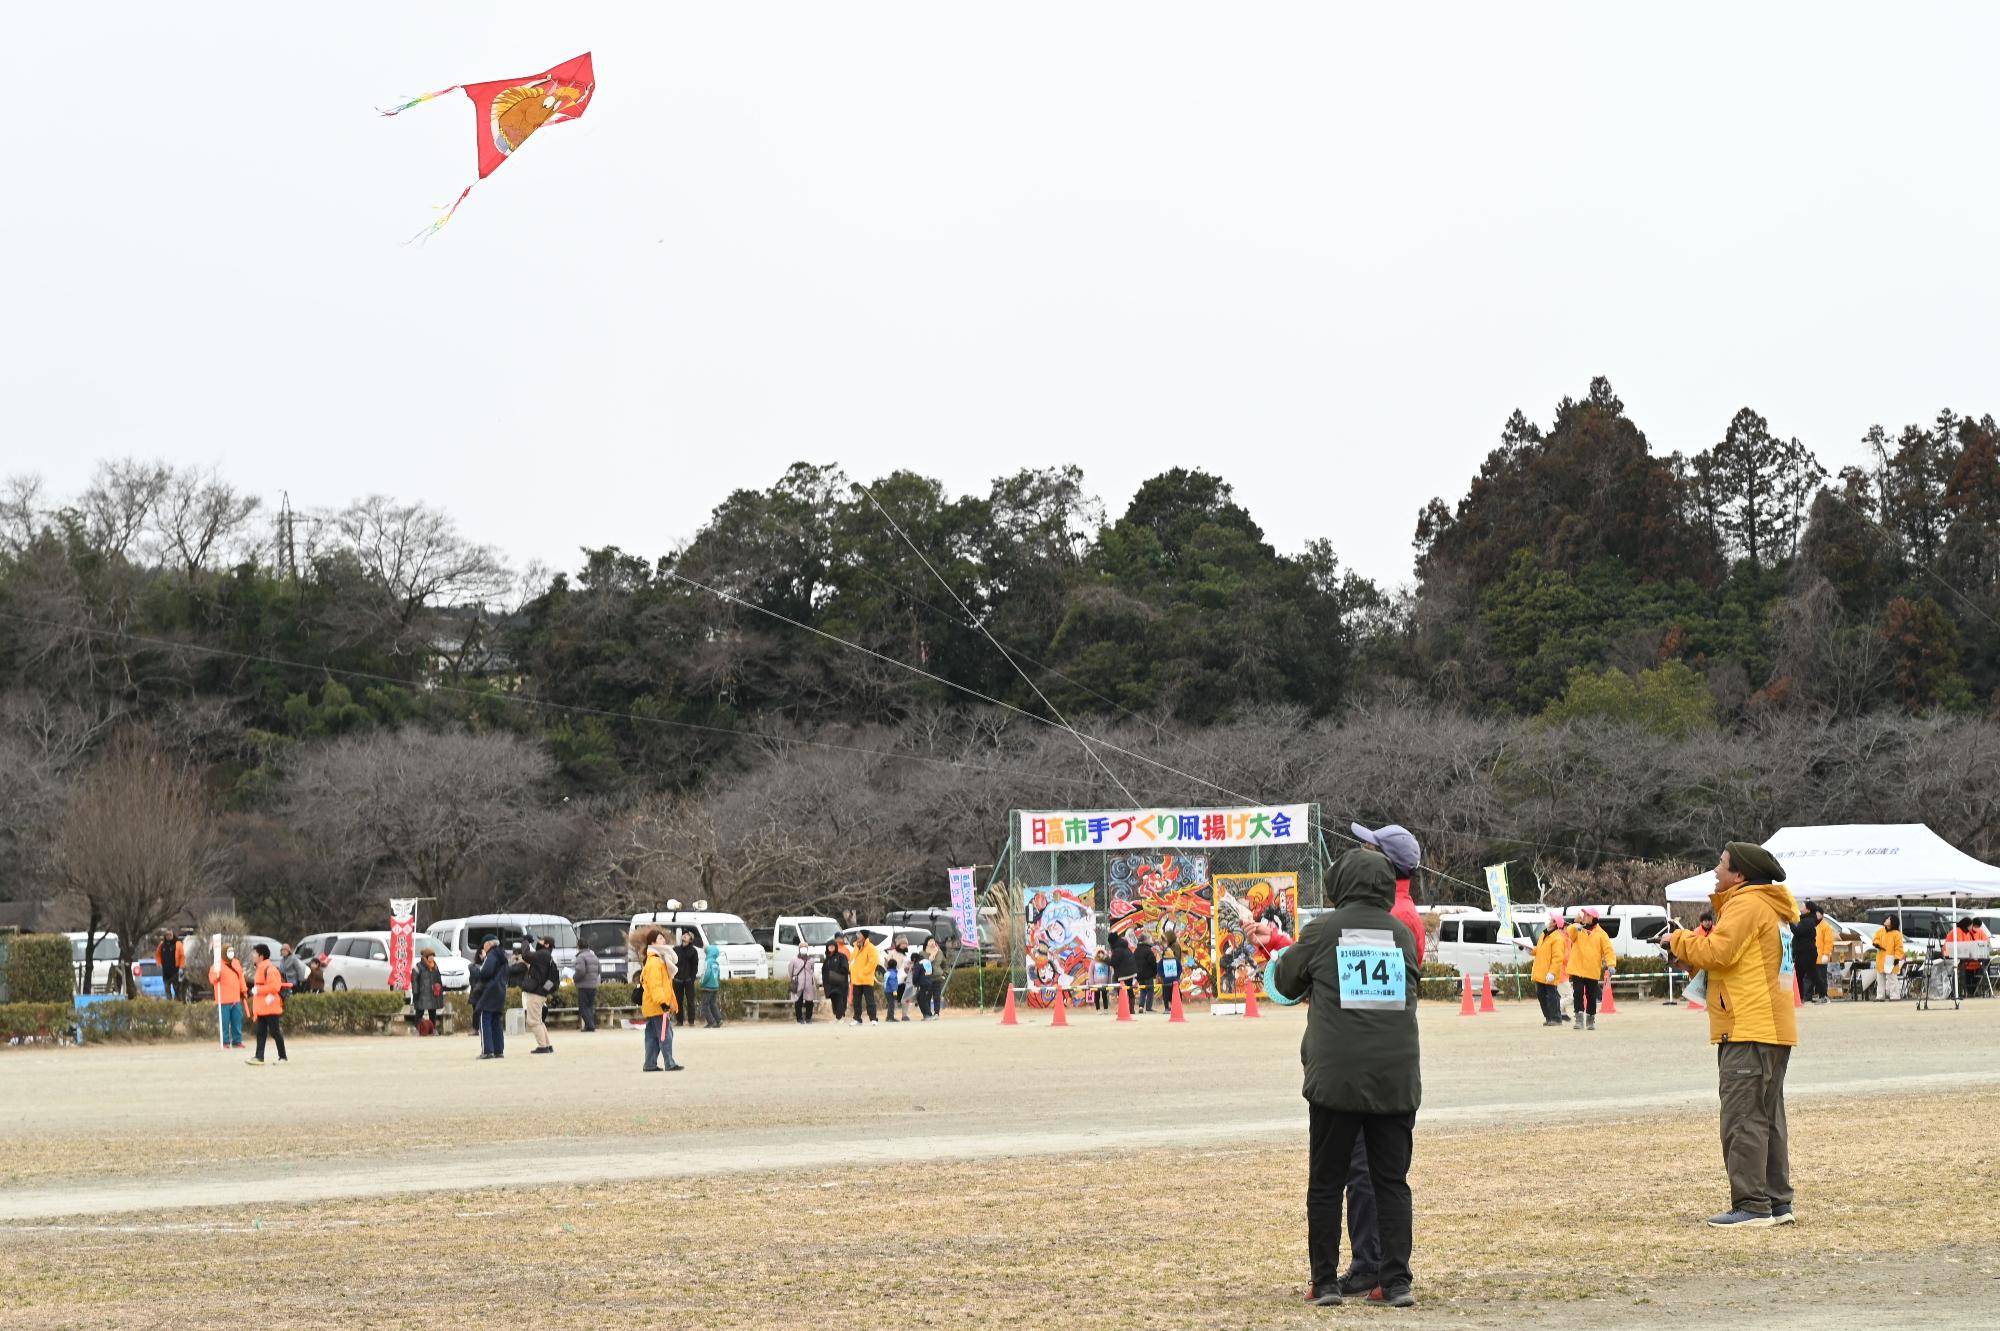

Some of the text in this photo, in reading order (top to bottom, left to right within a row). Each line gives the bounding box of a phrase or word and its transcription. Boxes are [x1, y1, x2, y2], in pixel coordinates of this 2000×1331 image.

[1032, 812, 1291, 845] 日高市手づくり凧揚げ大会
[1355, 959, 1389, 985] 14
